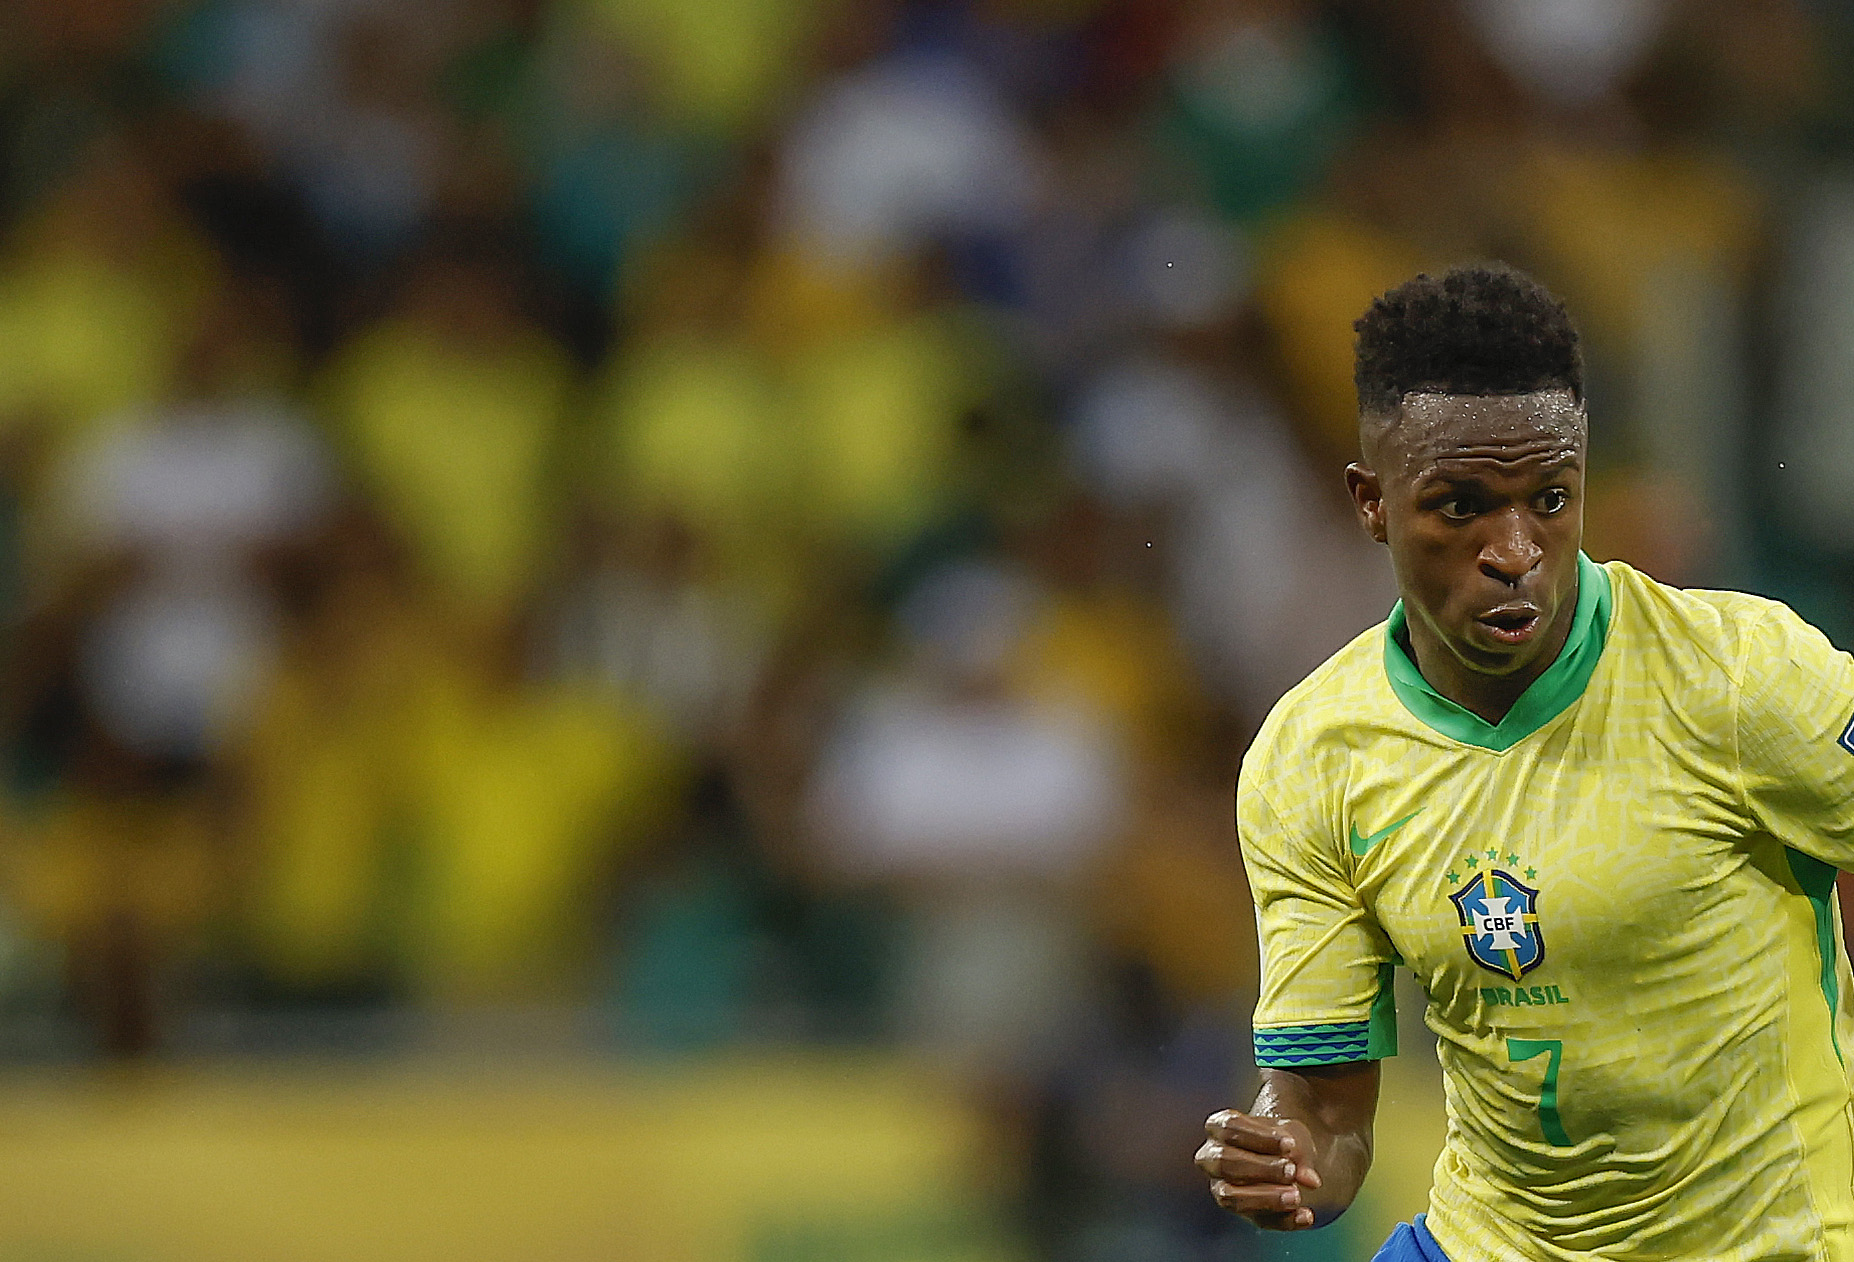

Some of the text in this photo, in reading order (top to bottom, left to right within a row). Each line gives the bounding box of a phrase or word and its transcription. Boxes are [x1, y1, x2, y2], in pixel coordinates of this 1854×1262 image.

[1483, 916, 1515, 932] CBF
[1481, 985, 1569, 1007] BRASIL
[1506, 1038, 1574, 1147] 7
